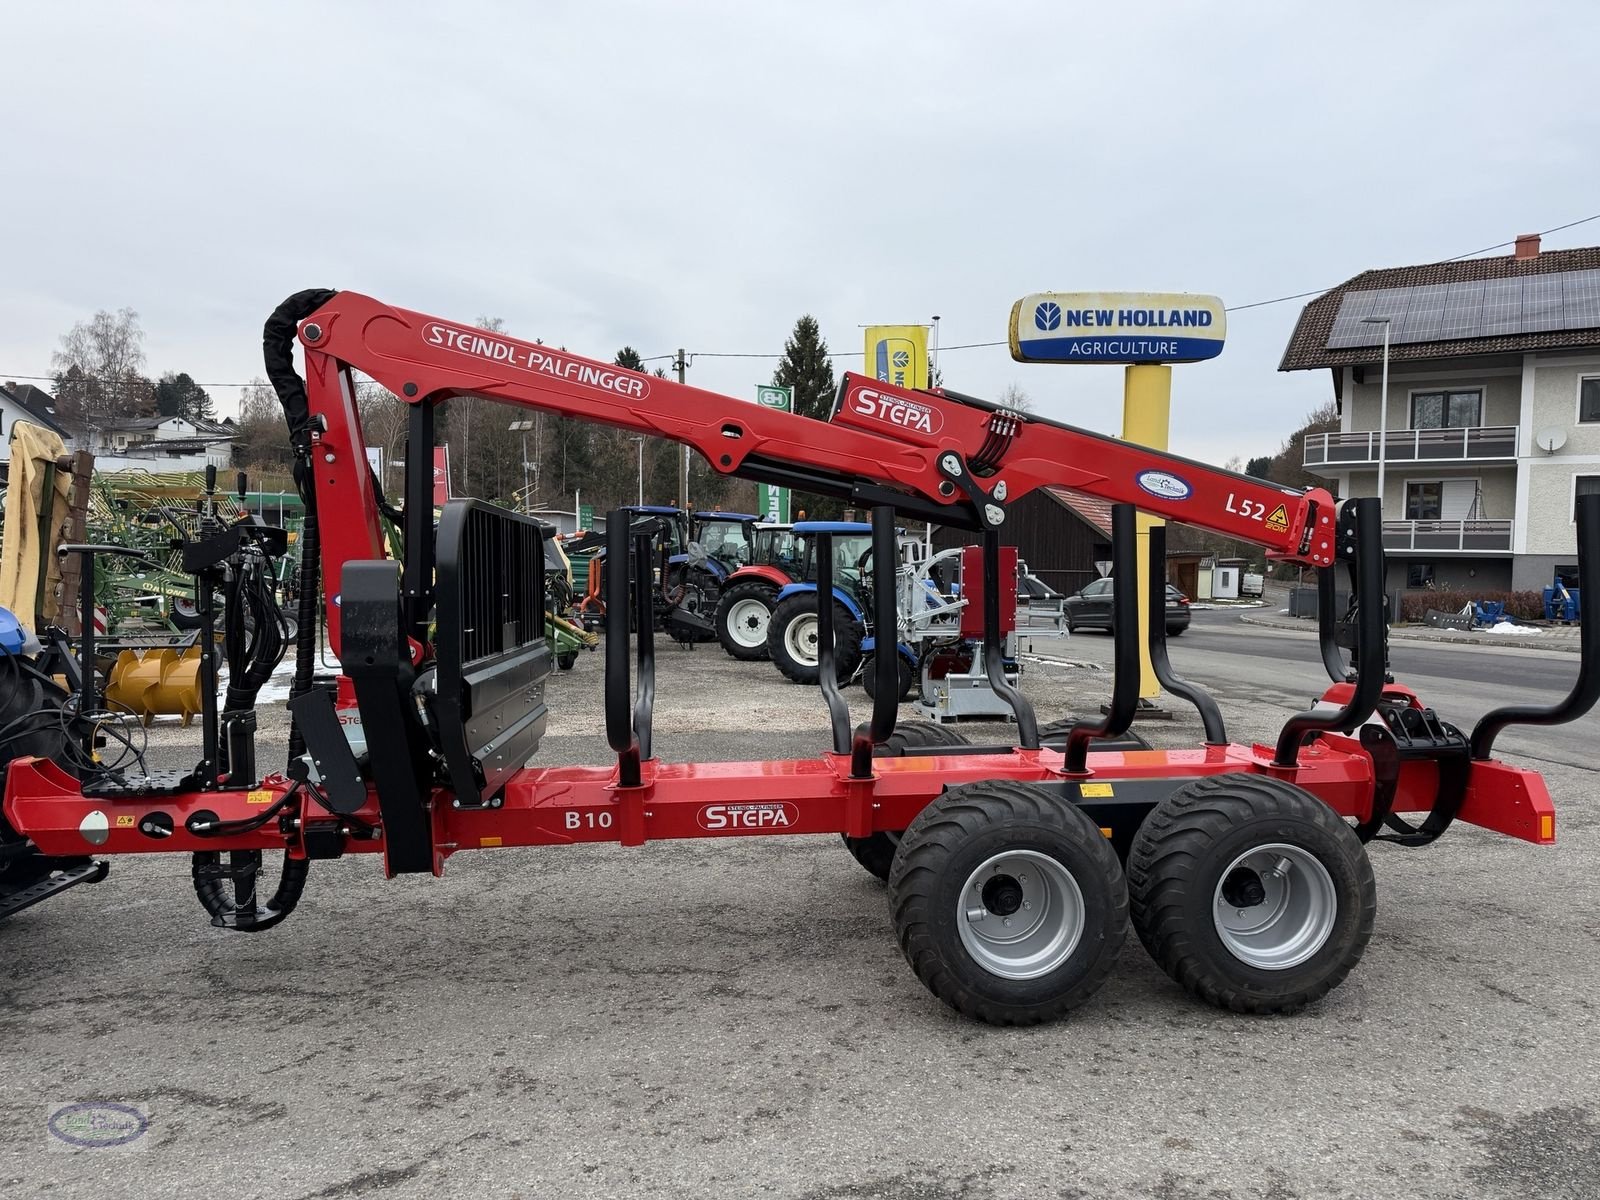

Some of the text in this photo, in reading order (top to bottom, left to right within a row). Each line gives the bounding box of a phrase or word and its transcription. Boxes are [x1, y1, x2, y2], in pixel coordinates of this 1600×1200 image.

[1067, 310, 1213, 327] NEW HOLLAND
[1070, 342, 1178, 355] AGRICULTURE
[428, 326, 644, 397] STEINDL-PALFINGER
[855, 389, 931, 433] STEPA
[339, 715, 362, 725] STE
[705, 806, 789, 828] STEPA
